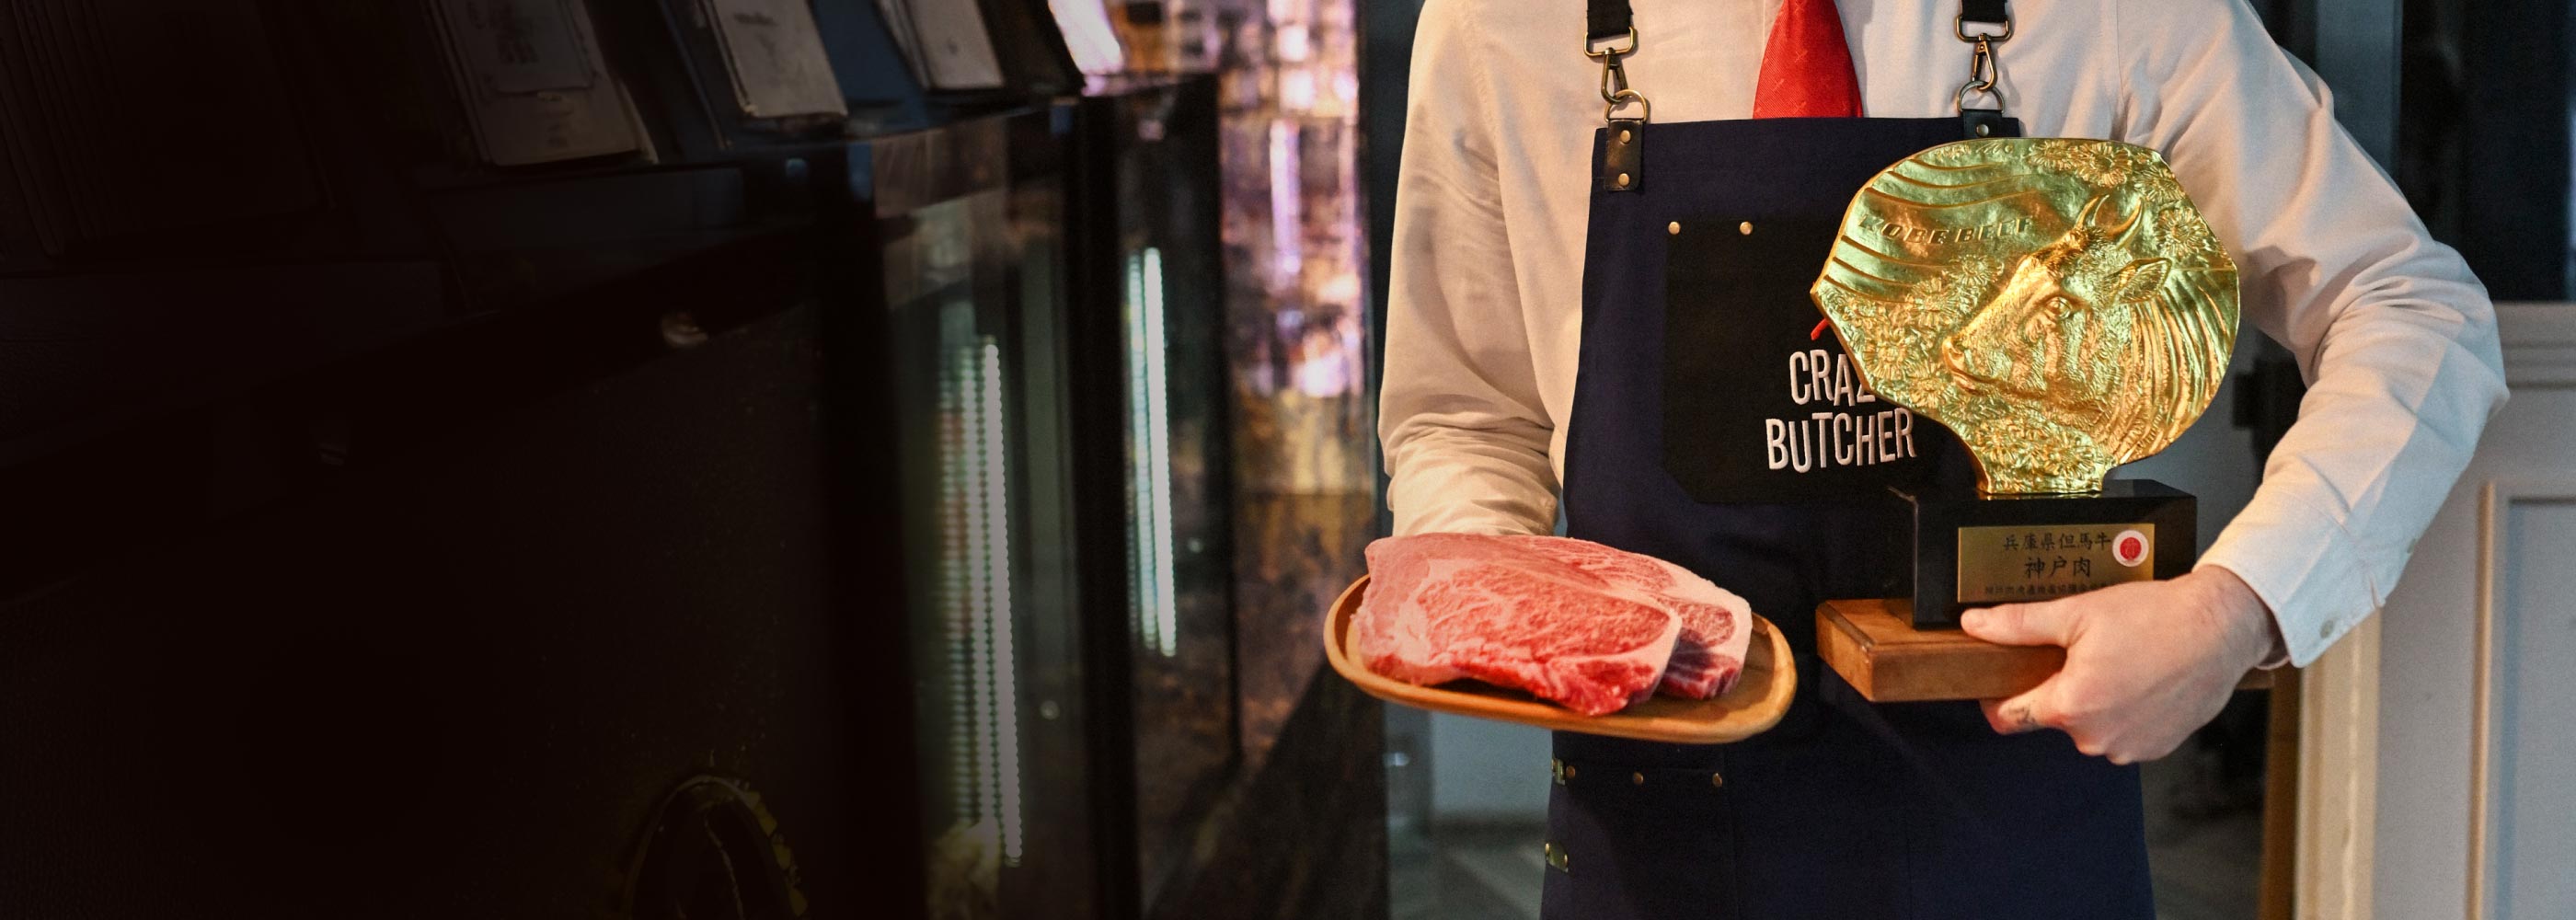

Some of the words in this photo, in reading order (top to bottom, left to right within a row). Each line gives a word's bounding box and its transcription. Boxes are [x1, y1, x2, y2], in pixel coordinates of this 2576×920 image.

[1857, 213, 1949, 245] KOBE
[1954, 215, 2034, 243] BEEF
[1765, 407, 1917, 474] BUTCHER
